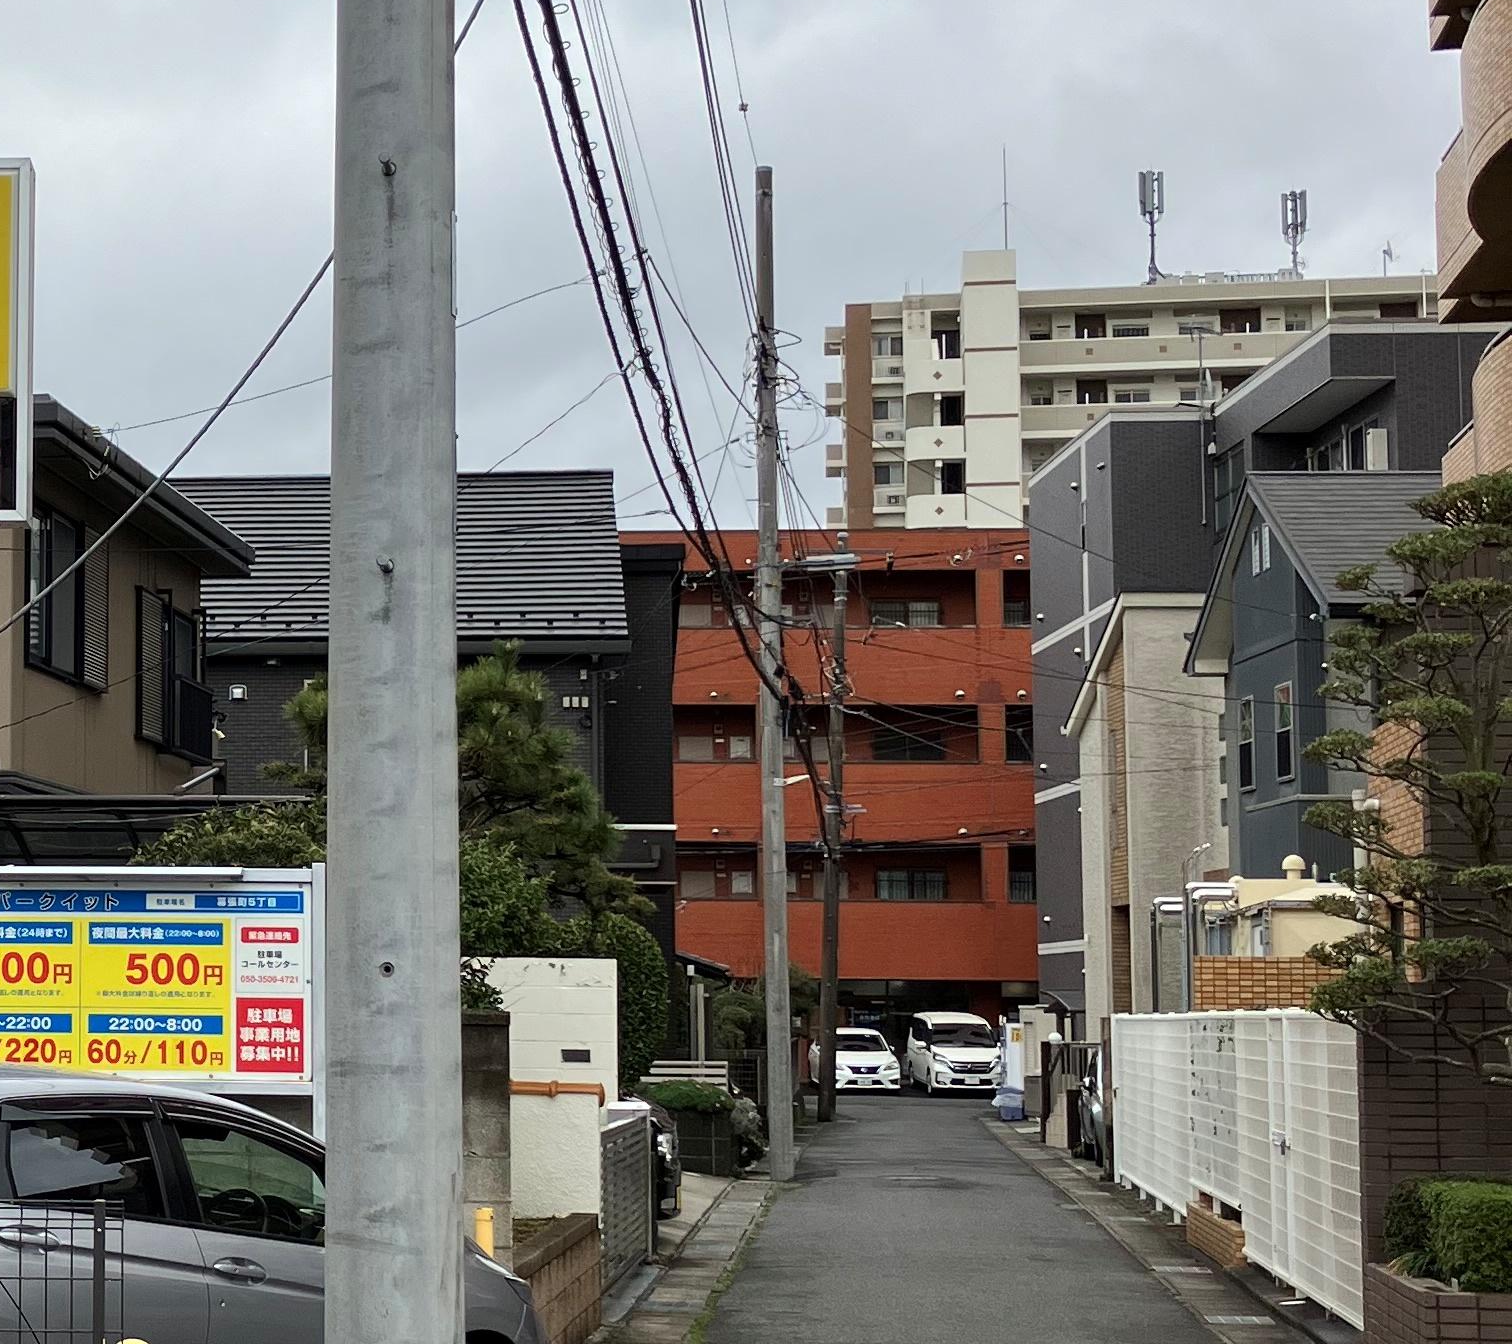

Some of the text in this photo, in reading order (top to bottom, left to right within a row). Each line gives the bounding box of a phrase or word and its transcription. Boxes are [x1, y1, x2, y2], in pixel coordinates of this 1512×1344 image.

[125, 952, 224, 986] 500円
[241, 960, 299, 969] コールセンター
[247, 1007, 293, 1024] 駐車場
[239, 1026, 301, 1043] 事業用地
